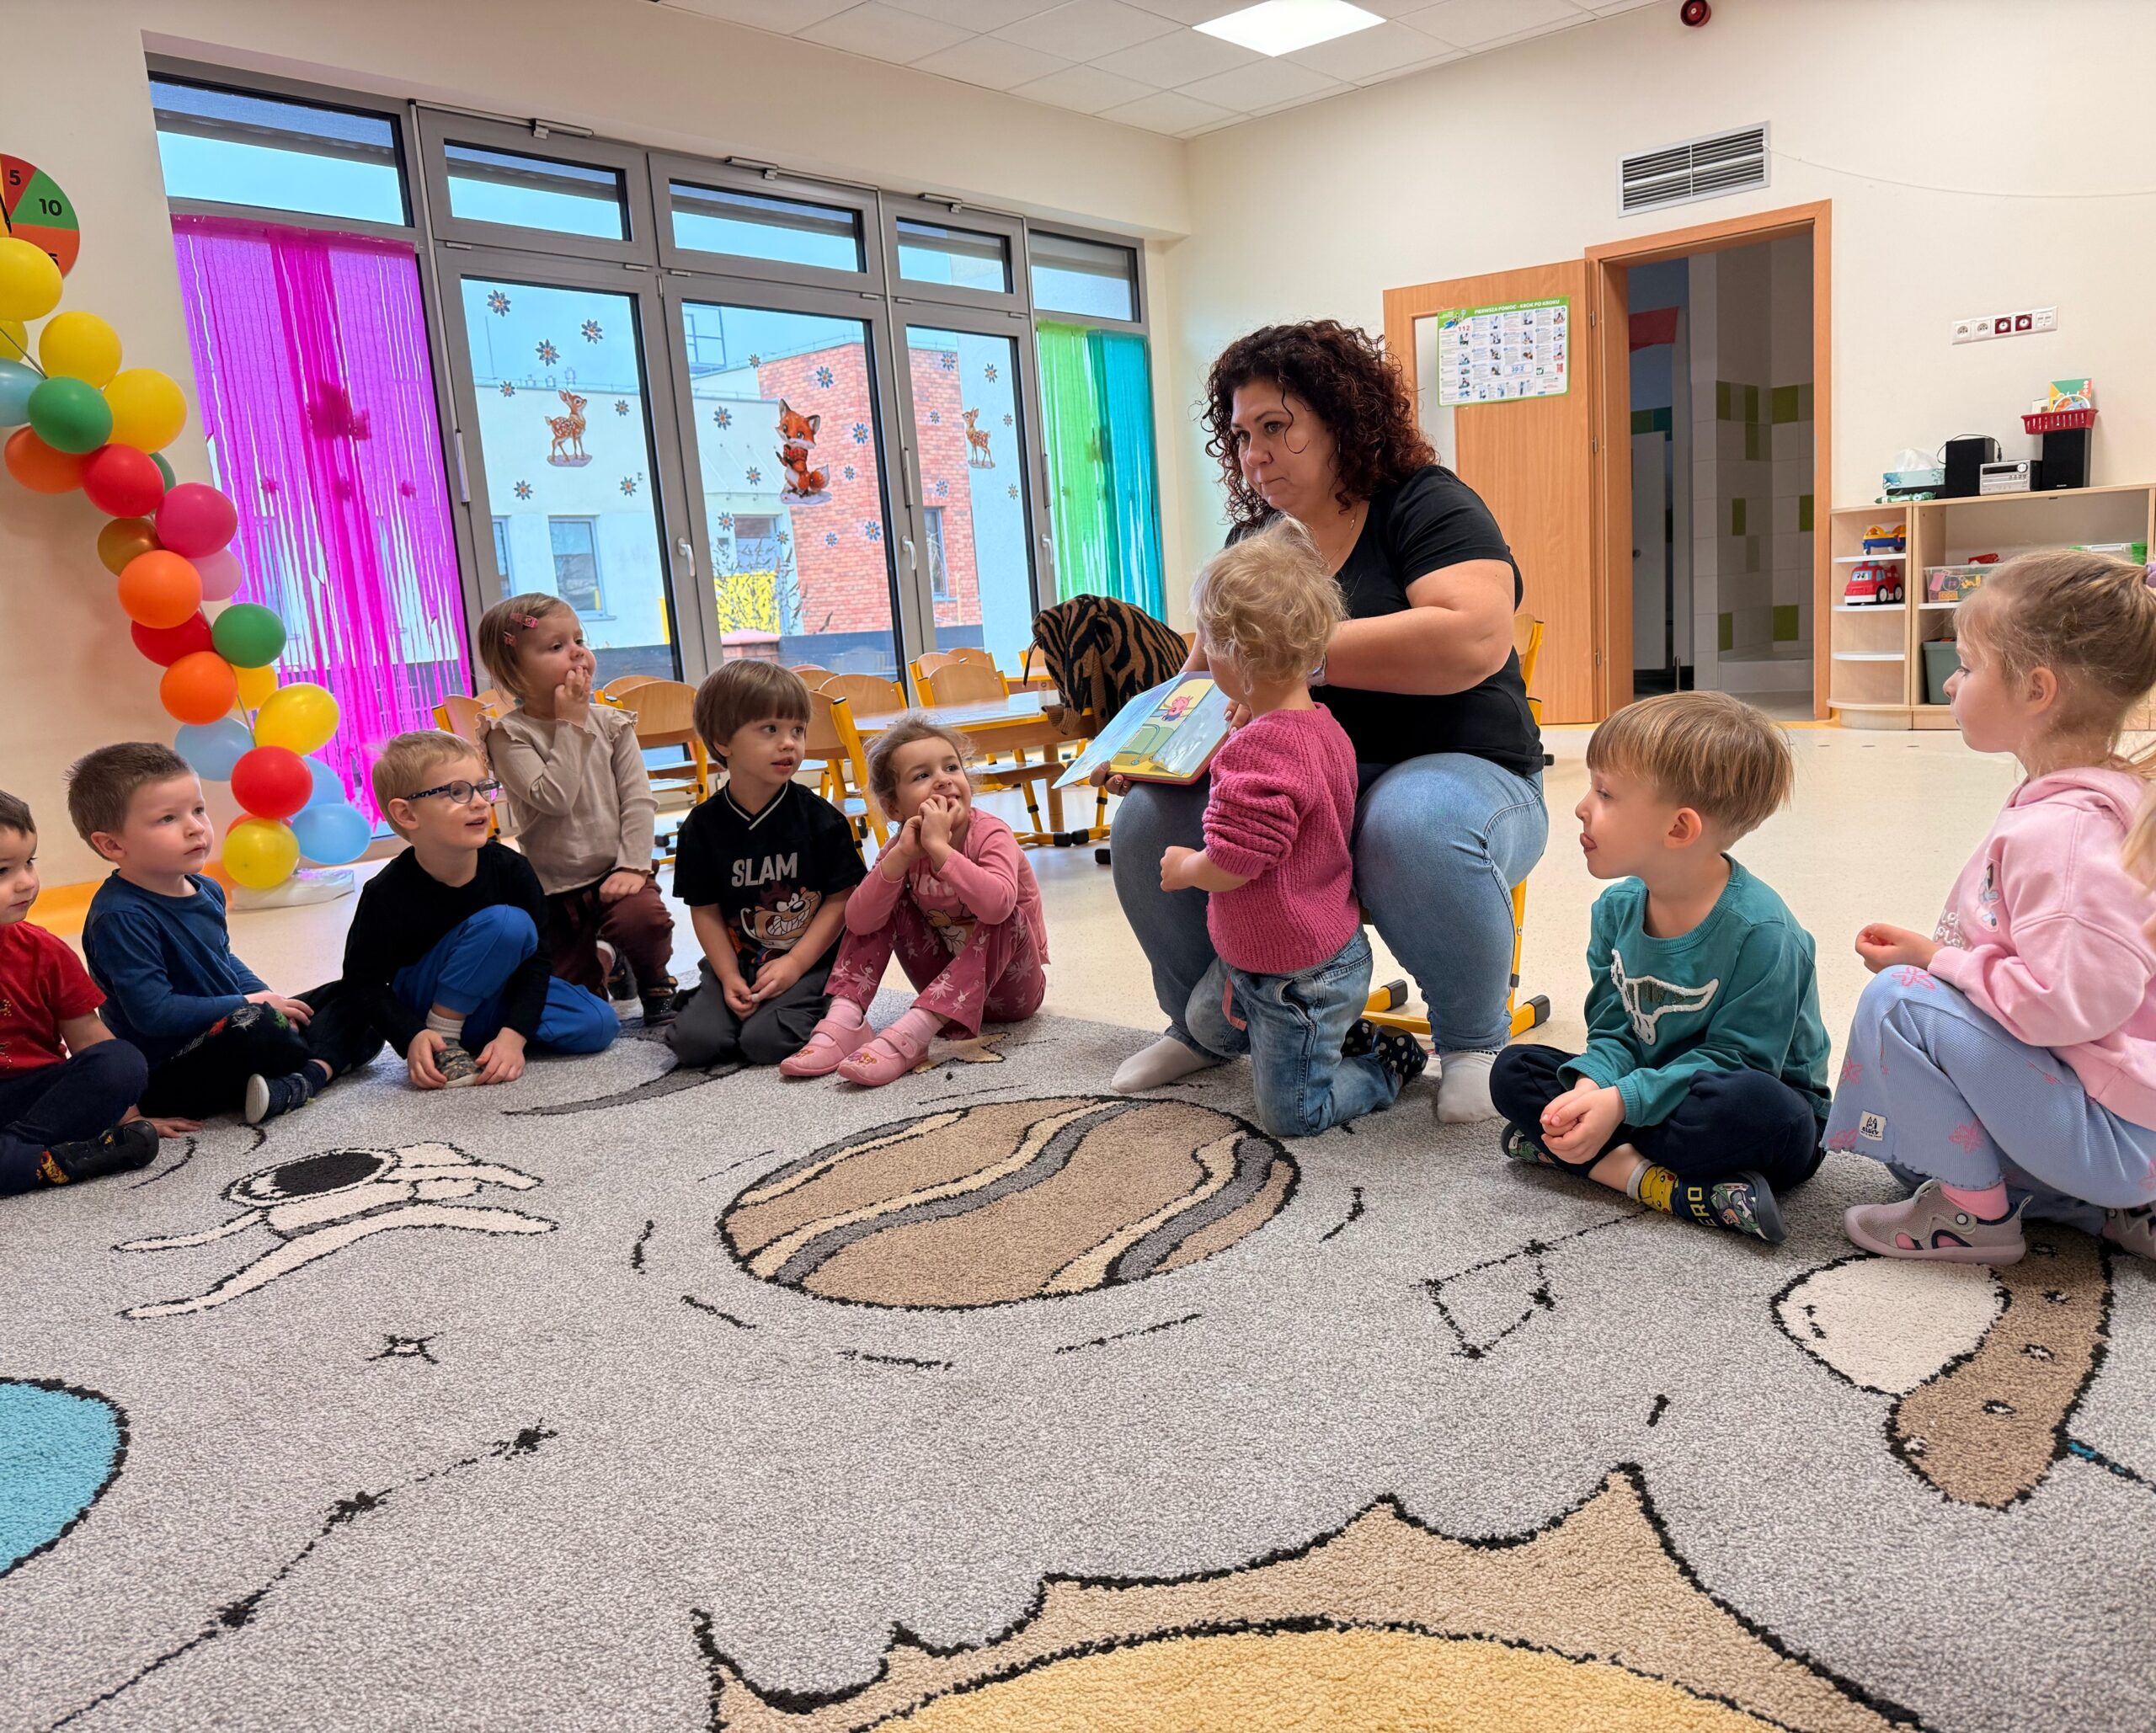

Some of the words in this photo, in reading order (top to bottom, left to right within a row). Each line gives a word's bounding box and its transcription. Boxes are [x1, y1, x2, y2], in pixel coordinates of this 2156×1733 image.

[9, 169, 21, 186] 5
[39, 198, 62, 216] 10
[731, 851, 798, 888] SLAM
